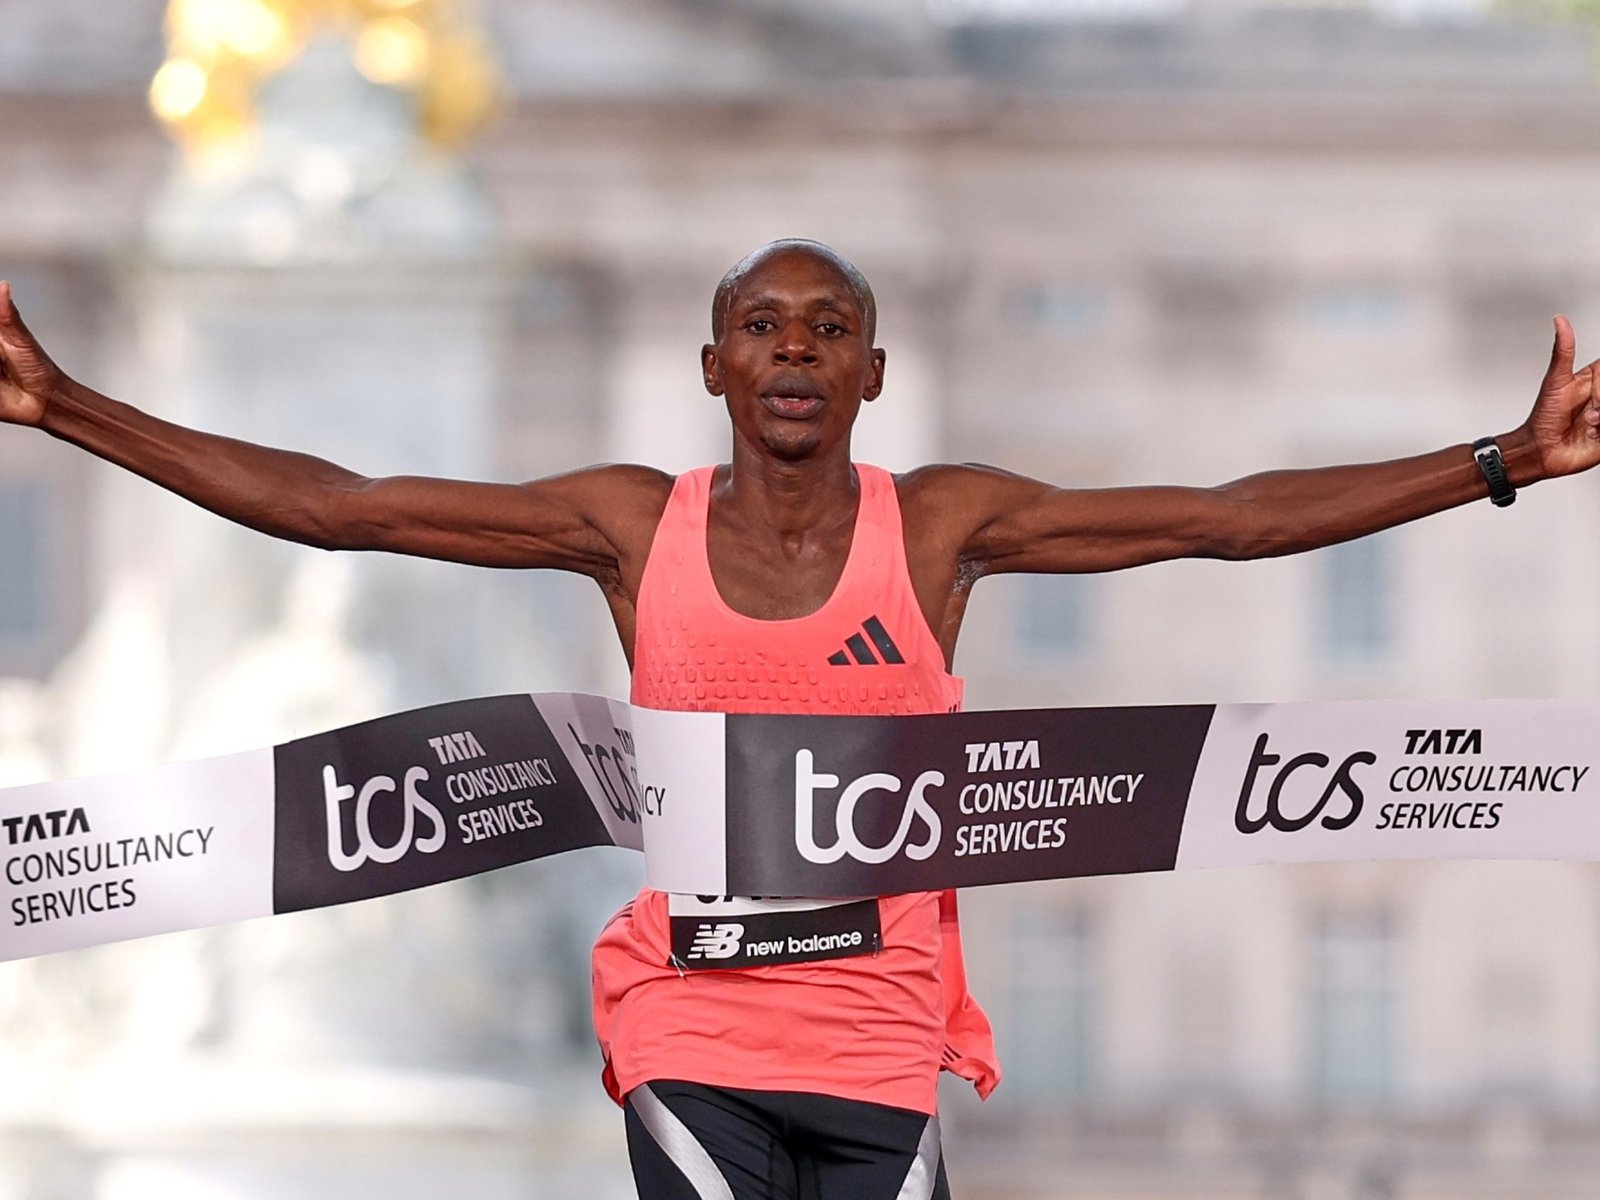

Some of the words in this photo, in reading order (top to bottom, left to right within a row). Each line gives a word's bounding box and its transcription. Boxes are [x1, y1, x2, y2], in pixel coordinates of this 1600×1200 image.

[428, 731, 486, 765] TATA
[965, 740, 1040, 773] TATA
[1405, 729, 1482, 754] TATA
[446, 758, 558, 804] CONSULTANCY
[959, 773, 1144, 814] CONSULTANCY
[1235, 732, 1377, 834] tcs
[1389, 765, 1590, 792] CONSULTANCY
[322, 764, 446, 872] tcs
[458, 798, 543, 844] SERVICES
[795, 748, 945, 864] tcs
[1375, 803, 1503, 829] SERVICES
[2, 807, 91, 845] TATA
[954, 818, 1067, 856] SERVICES
[6, 826, 215, 886] CONSULTANCY
[11, 878, 137, 926] SERVICES
[687, 923, 745, 960] NB
[746, 938, 786, 957] new
[788, 931, 862, 954] balance
